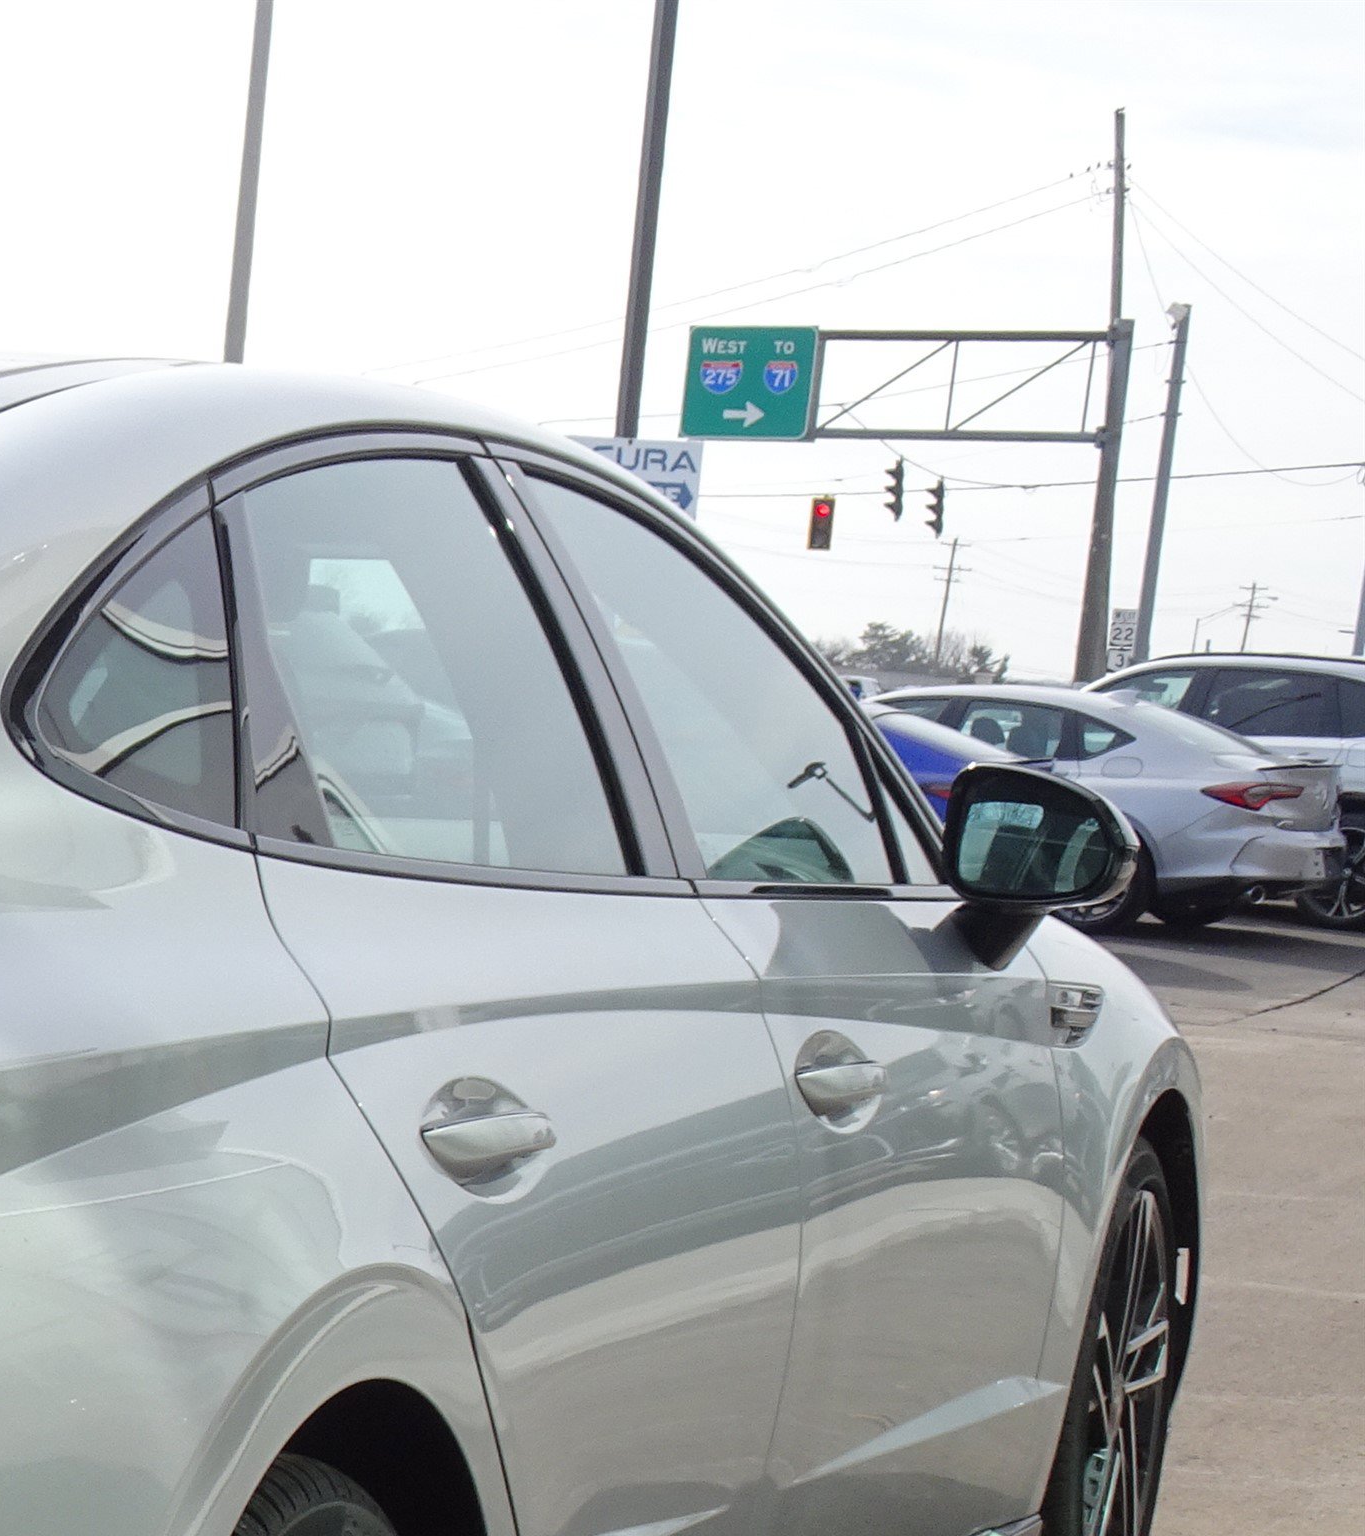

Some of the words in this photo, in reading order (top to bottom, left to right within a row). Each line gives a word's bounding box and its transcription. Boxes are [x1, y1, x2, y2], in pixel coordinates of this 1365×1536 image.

[701, 338, 748, 355] WEST
[773, 340, 795, 355] TO
[704, 367, 738, 386] 275
[772, 368, 792, 388] 71
[592, 445, 697, 473] URA
[1112, 627, 1134, 641] 22
[1114, 653, 1125, 668] 3
